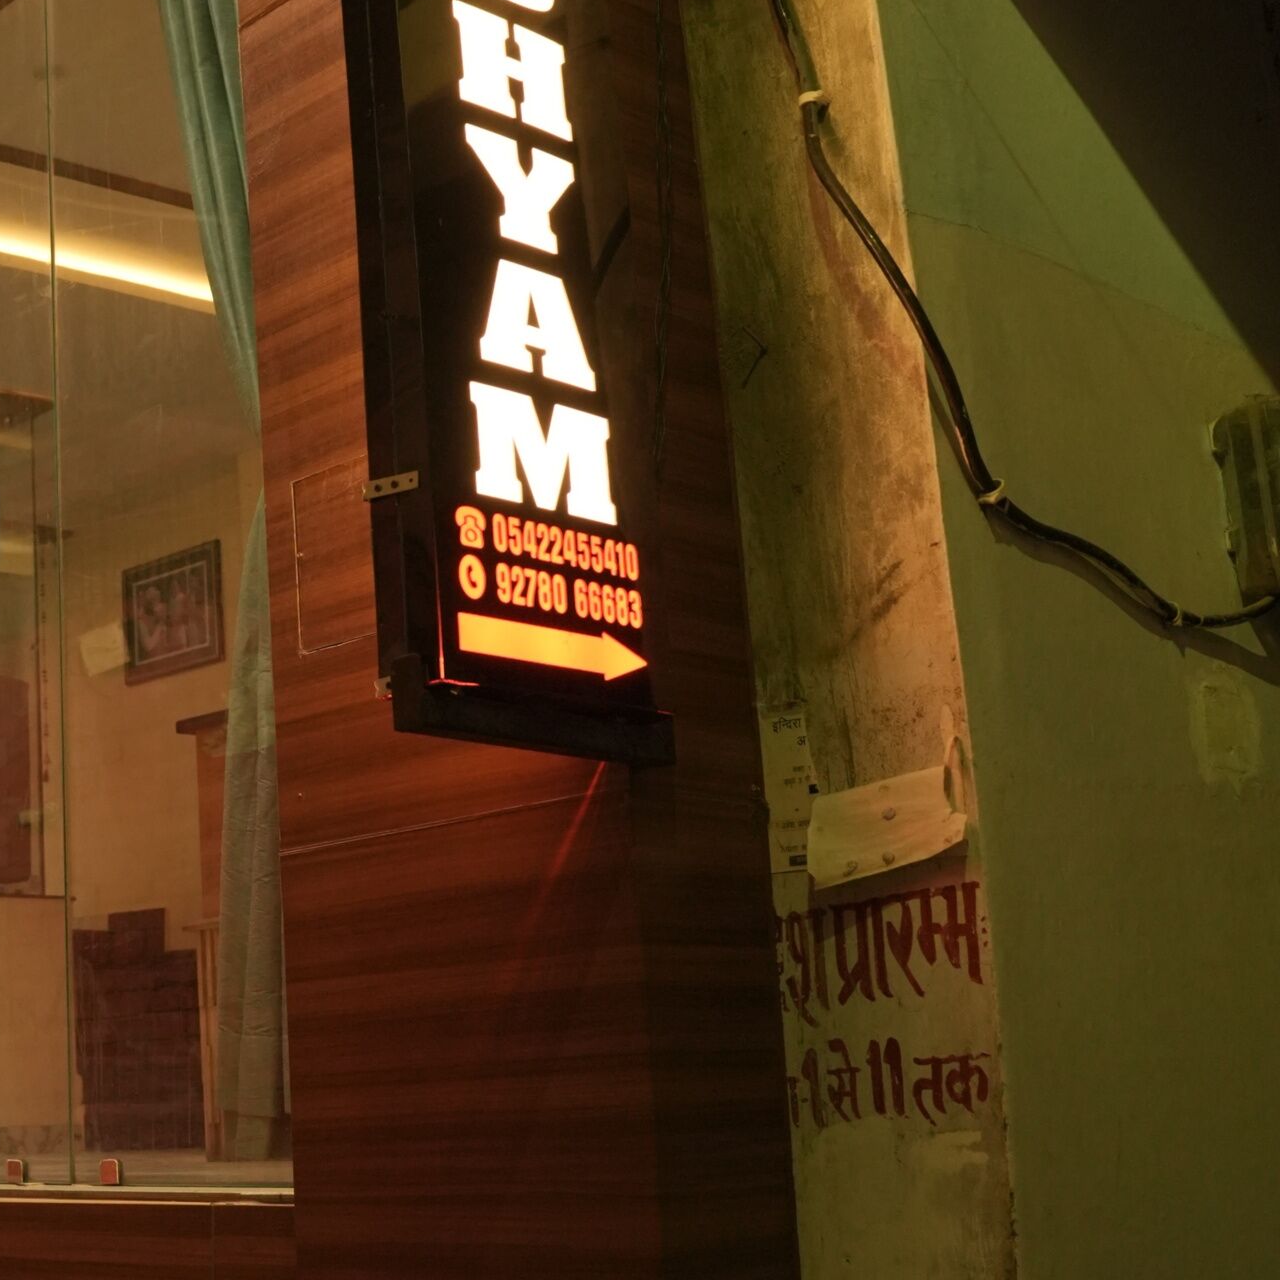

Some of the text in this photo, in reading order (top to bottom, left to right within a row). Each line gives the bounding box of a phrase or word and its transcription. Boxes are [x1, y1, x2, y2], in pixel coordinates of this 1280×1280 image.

[492, 513, 640, 581] 05422455410
[496, 562, 643, 629] 92780 66683
[912, 1052, 991, 1126] तक
